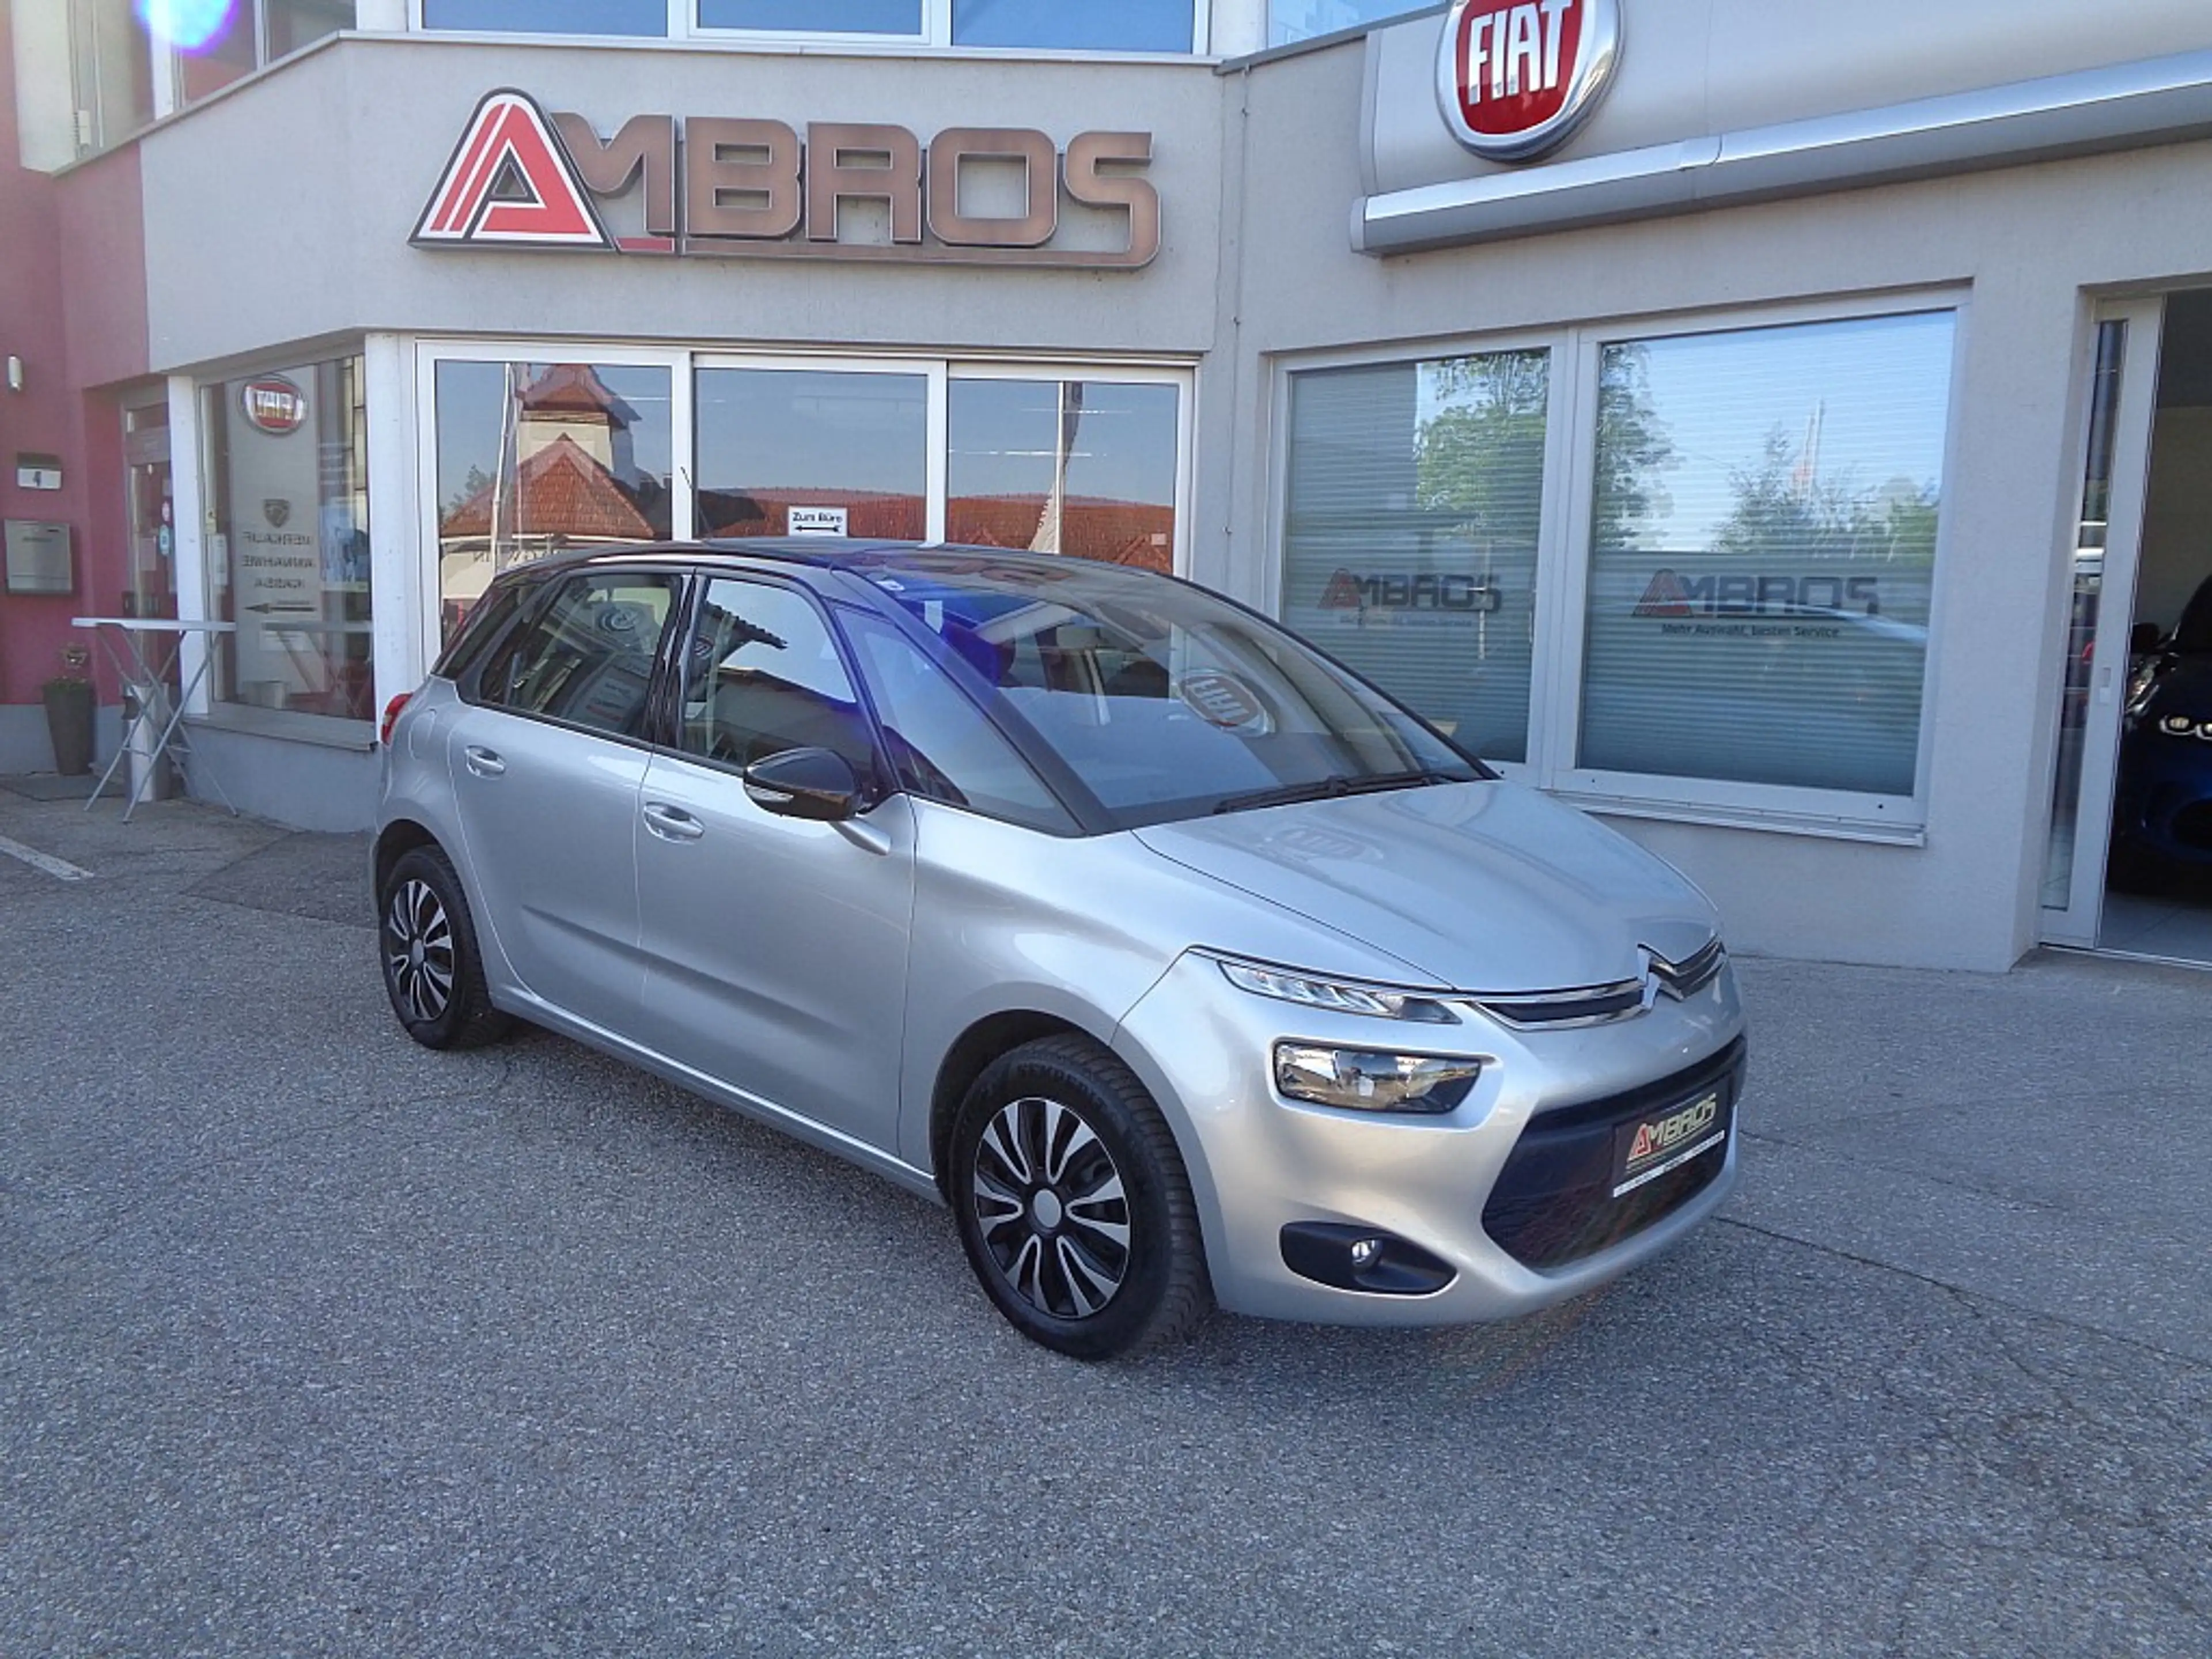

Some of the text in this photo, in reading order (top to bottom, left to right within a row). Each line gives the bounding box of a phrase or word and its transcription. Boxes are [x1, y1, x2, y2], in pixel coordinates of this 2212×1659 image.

[1468, 0, 1573, 105] FIAT
[407, 86, 1161, 270] AMBROS
[793, 512, 815, 521] Zum
[1317, 568, 1502, 612] AMBROS
[1632, 569, 1879, 618] AMBROS
[1626, 1093, 1717, 1162] AMBROS
